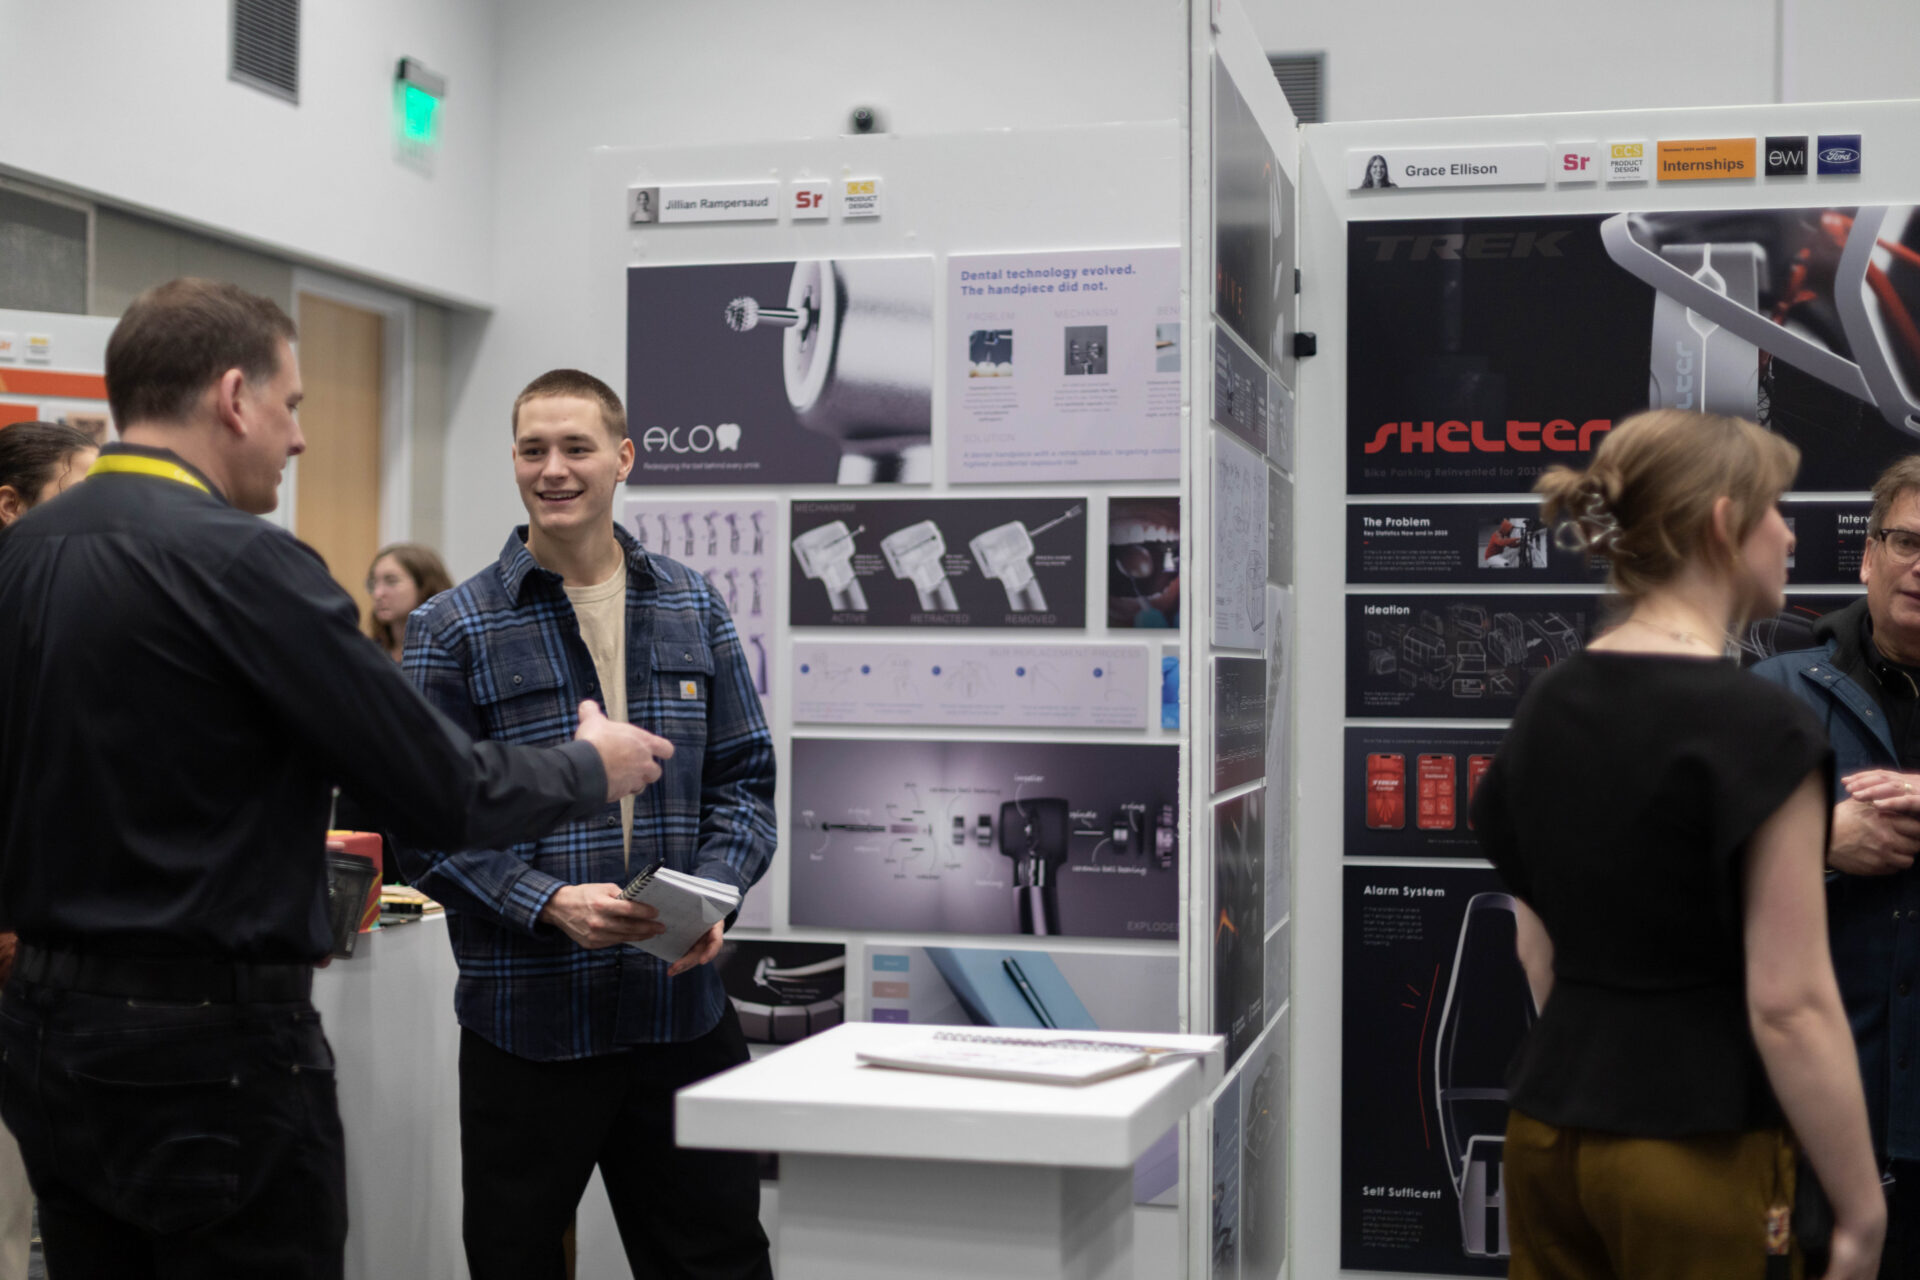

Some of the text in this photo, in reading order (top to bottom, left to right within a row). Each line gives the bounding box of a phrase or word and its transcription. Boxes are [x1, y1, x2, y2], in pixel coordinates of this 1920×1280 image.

[1612, 144, 1642, 157] CCS
[1826, 148, 1852, 161] Ford
[1563, 154, 1591, 171] Sr
[1611, 159, 1643, 167] PRODUCT
[1769, 149, 1804, 166] ewi
[1405, 163, 1498, 177] Grace Ellison
[1663, 158, 1745, 173] Internships
[665, 196, 769, 210] Jillian Rampersaud
[796, 191, 823, 209] Sr
[848, 202, 875, 210] DESIGN
[1366, 230, 1573, 262] TREK
[961, 264, 1136, 281] Dental technology evolved.
[961, 281, 1108, 296] The handpiece did not.
[967, 311, 1016, 321] PROBLEM
[1054, 308, 1118, 319] MECHANISM
[643, 424, 715, 453] ACO
[963, 433, 1016, 443] SOLUTION
[1364, 468, 1387, 477] Bike
[1391, 467, 1432, 479] Parking
[1434, 467, 1497, 477] Reinvented
[1499, 466, 1514, 476] for
[794, 503, 856, 512] MECHANISM
[1363, 517, 1431, 527] The Problem
[1838, 514, 1872, 525] Interv
[1364, 605, 1410, 615] Ideation
[831, 614, 867, 623] ACTIVE
[911, 614, 970, 624] RETRACTED
[1005, 614, 1057, 624] REMOVED
[1363, 885, 1445, 898] Alarm System
[1127, 921, 1178, 933] EXPLODE
[1362, 1186, 1442, 1199] Self Sufficent
